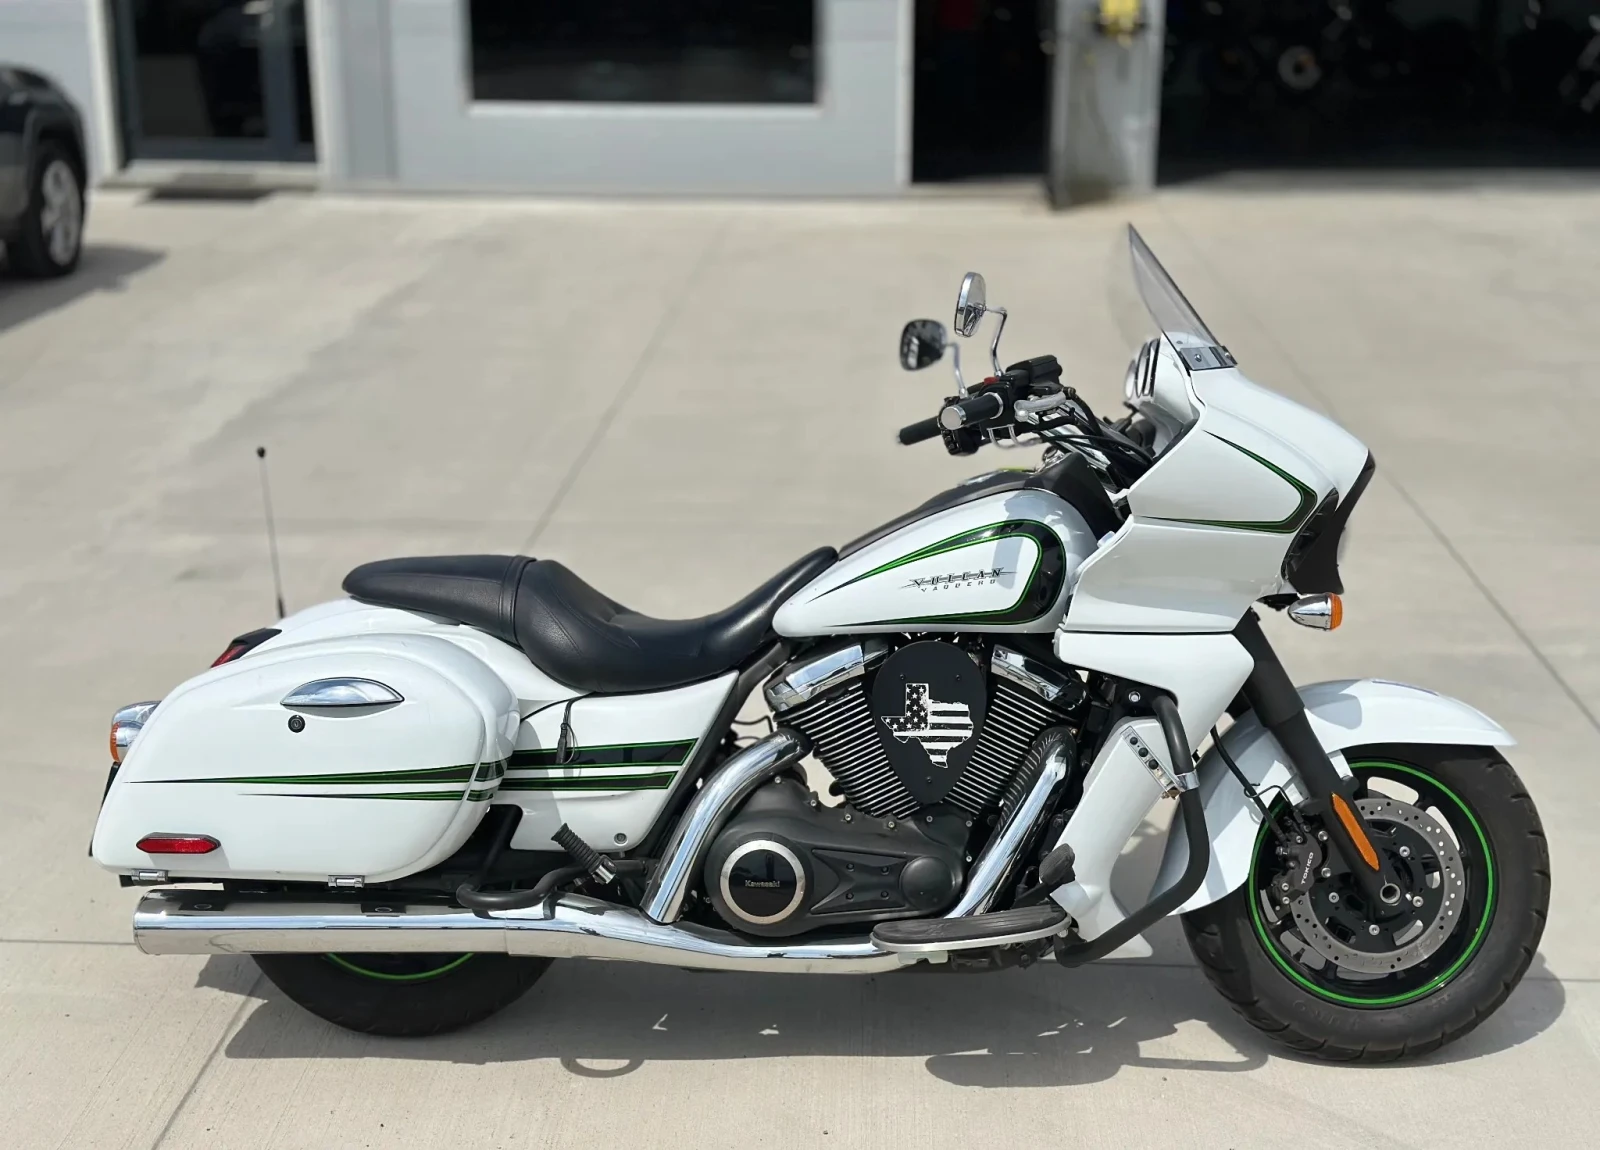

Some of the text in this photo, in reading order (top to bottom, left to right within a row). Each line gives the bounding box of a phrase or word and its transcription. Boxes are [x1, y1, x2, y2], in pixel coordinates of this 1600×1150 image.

[909, 567, 1005, 588] VULCAN
[921, 579, 996, 593] VAQUERO
[1301, 852, 1314, 885] TOKICO
[745, 880, 781, 888] Kawasaki
